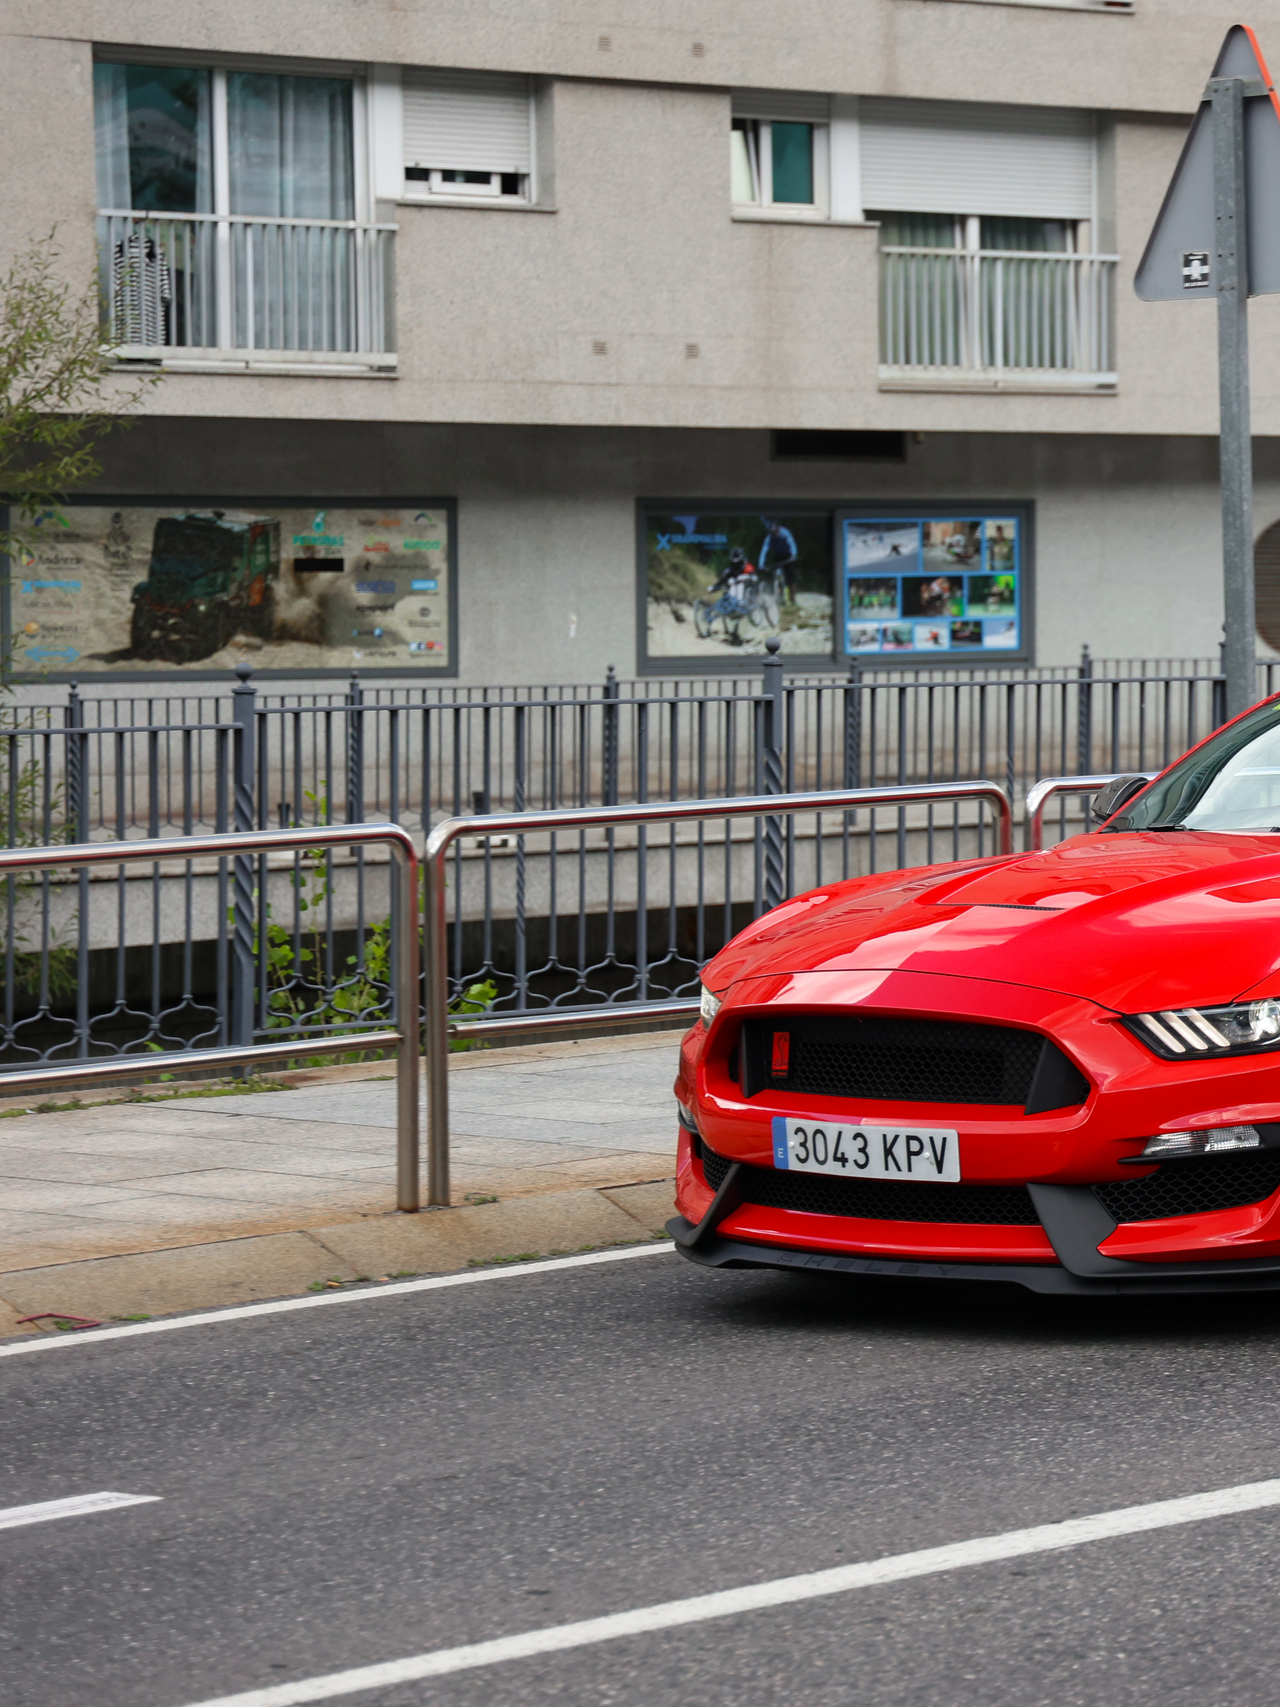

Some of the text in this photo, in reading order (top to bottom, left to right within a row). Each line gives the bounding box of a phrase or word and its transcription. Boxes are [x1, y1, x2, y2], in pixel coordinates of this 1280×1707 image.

[777, 1126, 948, 1175] E 3043 KPV
